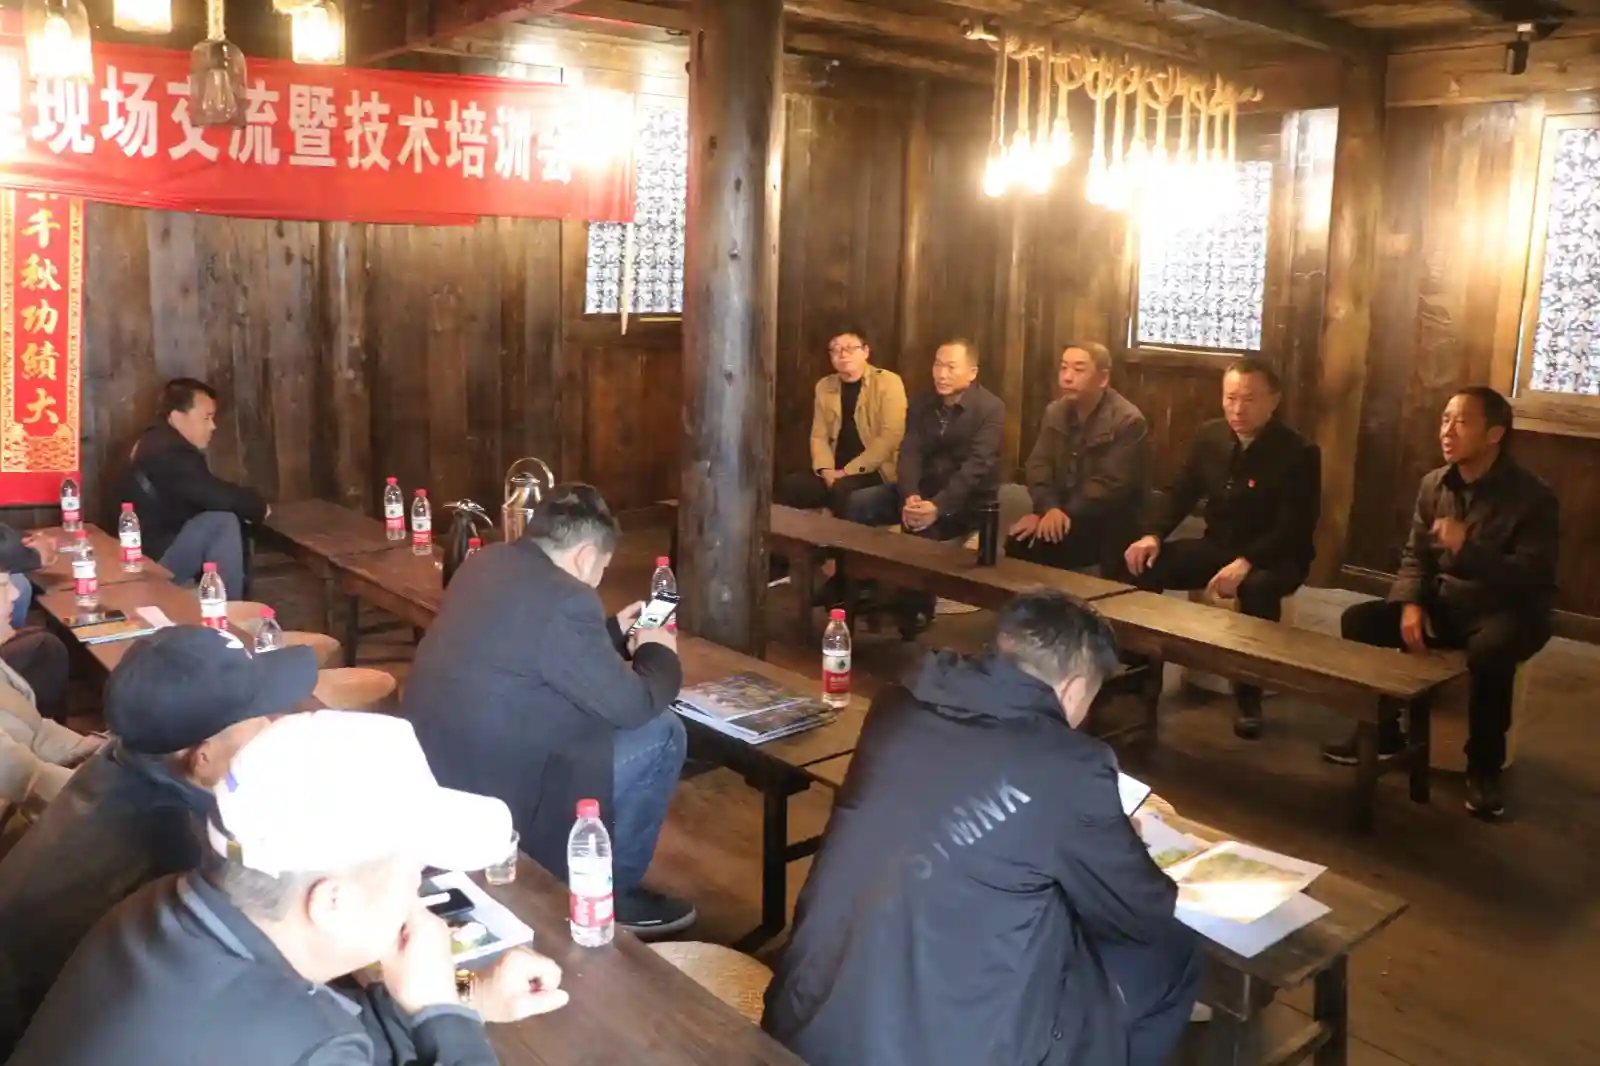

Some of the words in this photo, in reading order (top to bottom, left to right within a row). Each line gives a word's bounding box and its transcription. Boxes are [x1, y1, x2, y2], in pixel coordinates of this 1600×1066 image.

[0, 64, 573, 184] 现场交流暨技术培训会
[20, 191, 62, 424] 千秋功績大
